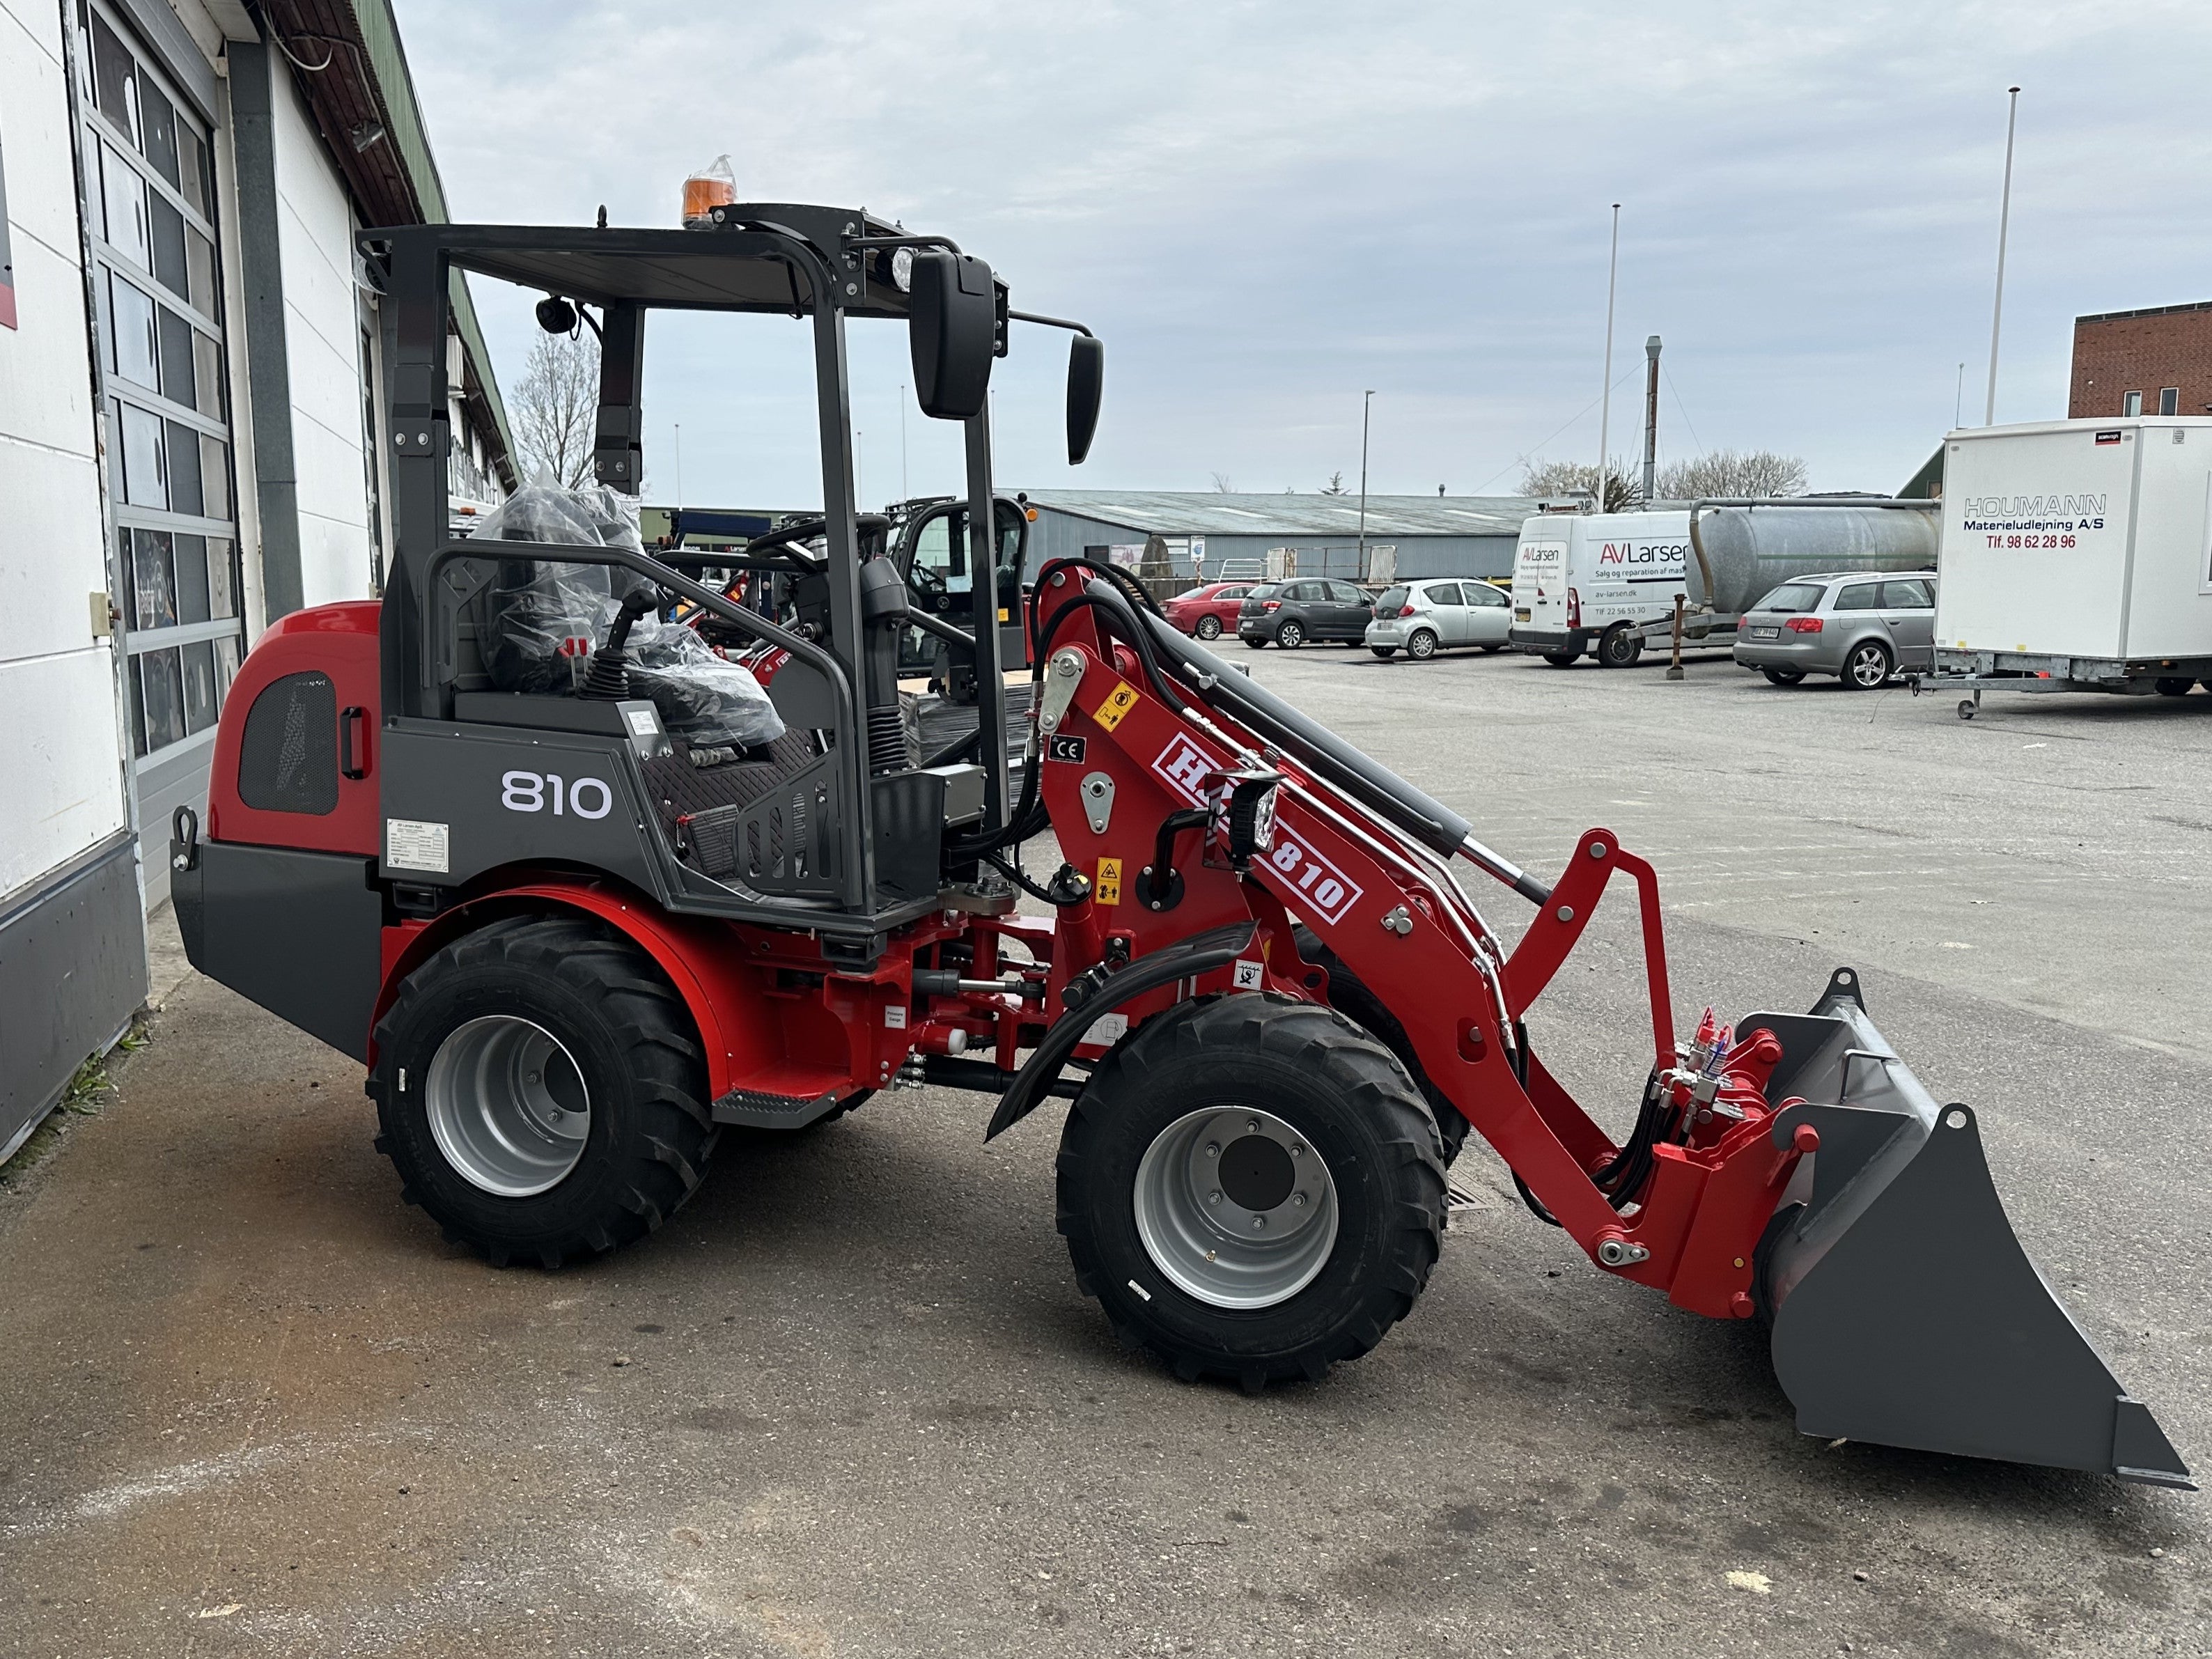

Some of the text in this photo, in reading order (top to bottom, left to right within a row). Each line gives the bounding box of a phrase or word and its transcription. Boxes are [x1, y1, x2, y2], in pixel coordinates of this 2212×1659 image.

[1965, 494, 2106, 517] HOUMANN
[1963, 518, 2104, 531] Materieludlejning A/S
[1986, 535, 2076, 549] Tlf. 98 62 28 96
[1621, 568, 1659, 577] reparation
[1595, 590, 1637, 598] av-larsen.dk
[1057, 741, 1078, 758] CE
[501, 770, 613, 820] 810
[1272, 841, 1345, 909] 810
